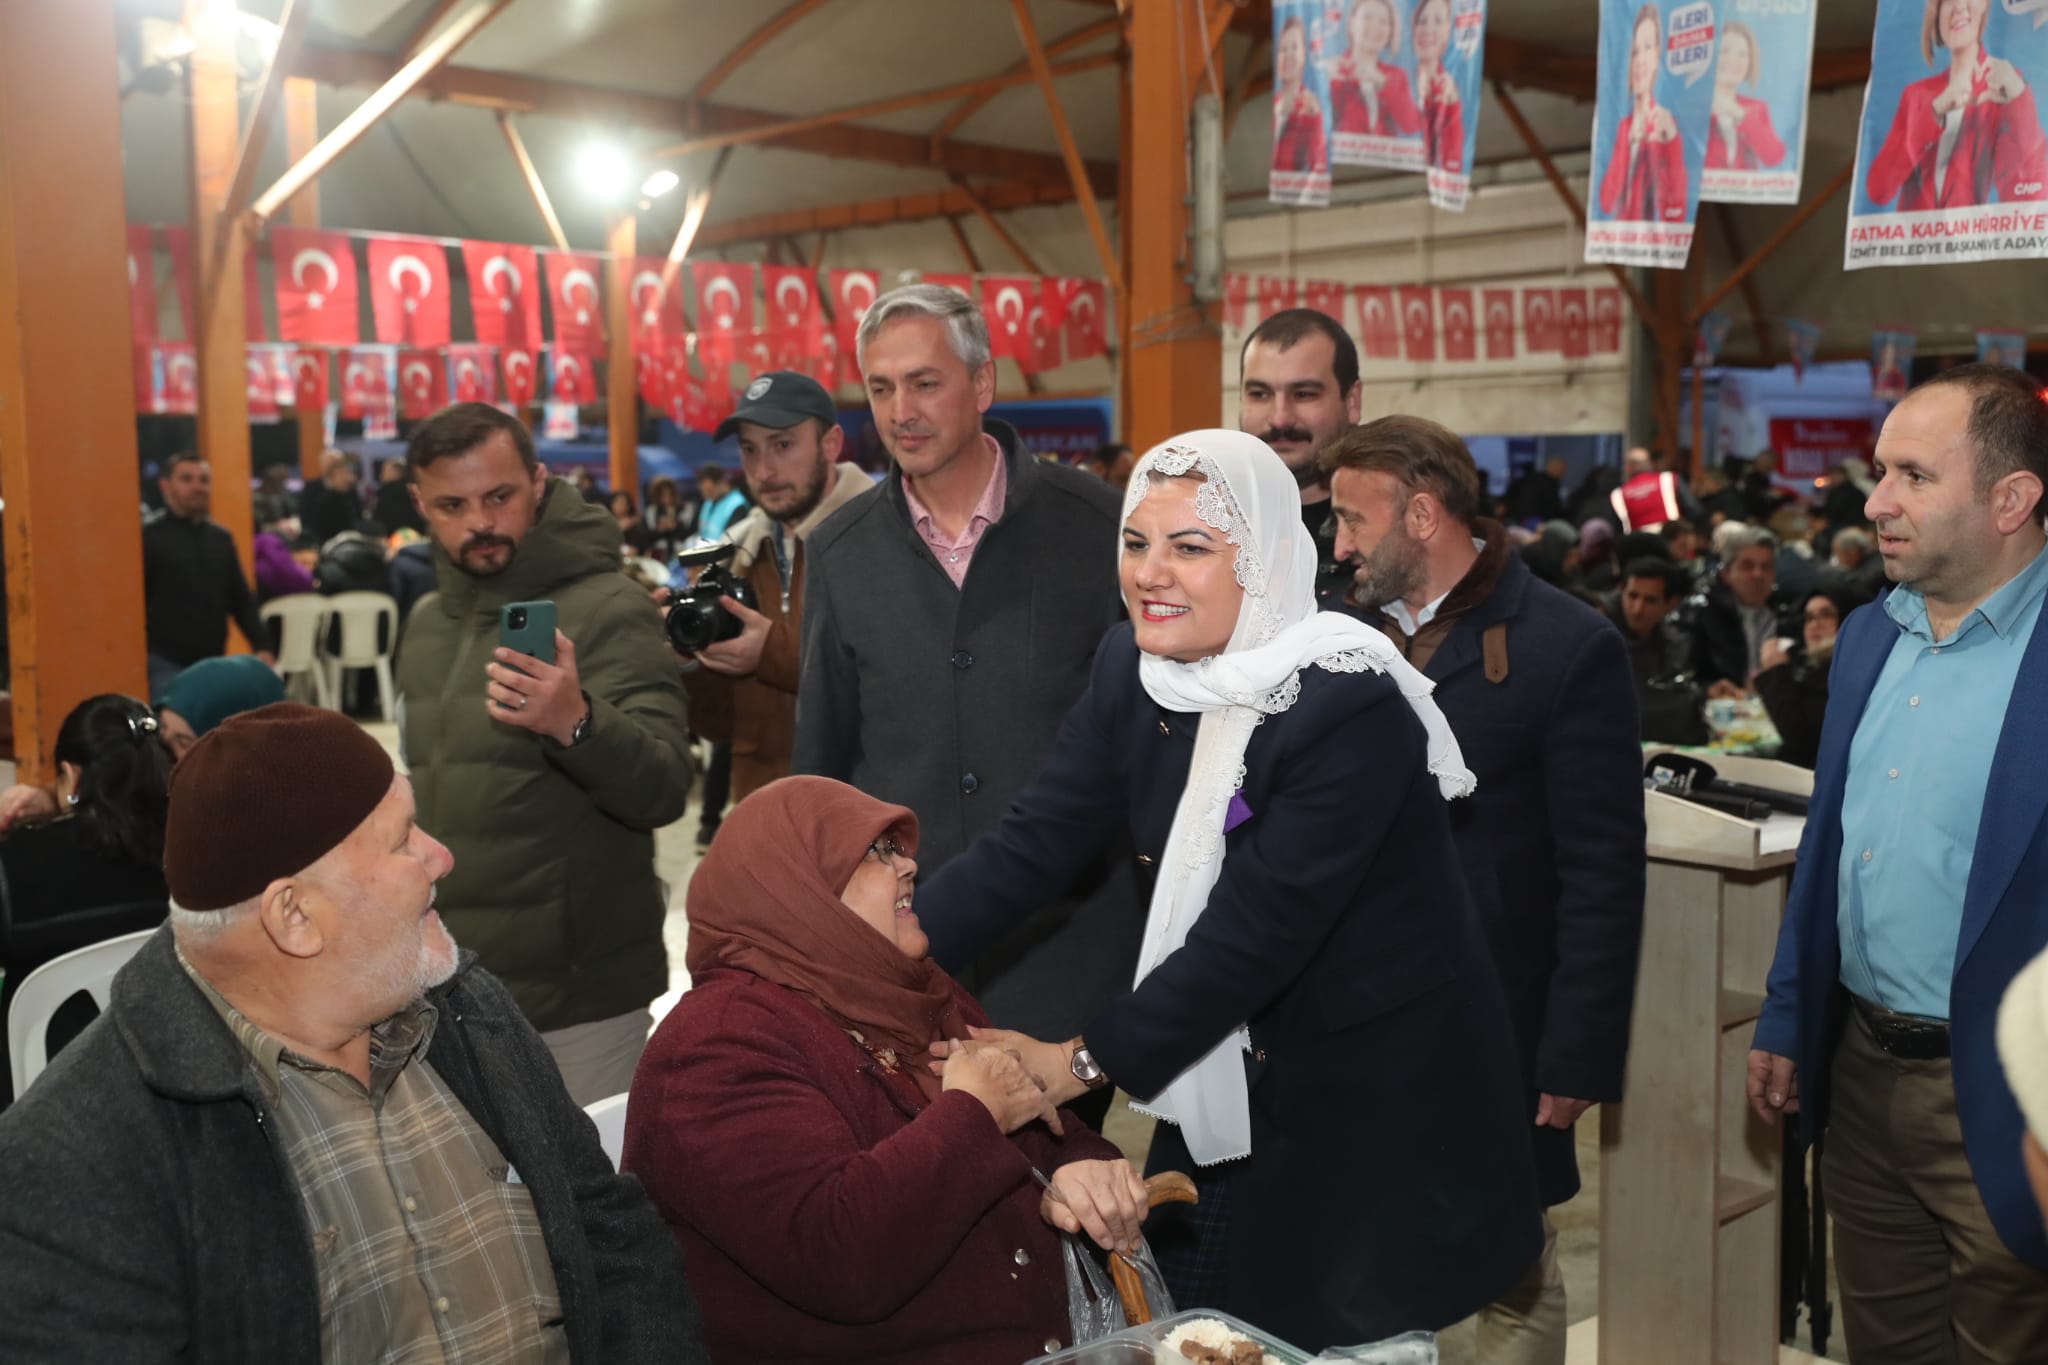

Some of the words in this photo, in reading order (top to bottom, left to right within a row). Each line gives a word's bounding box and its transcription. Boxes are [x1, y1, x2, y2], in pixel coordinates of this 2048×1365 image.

[2014, 182, 2042, 196] CHP
[1851, 224, 1905, 242] FATMA
[1911, 220, 1969, 238] KAPLAN
[2003, 235, 2048, 250] ADAY
